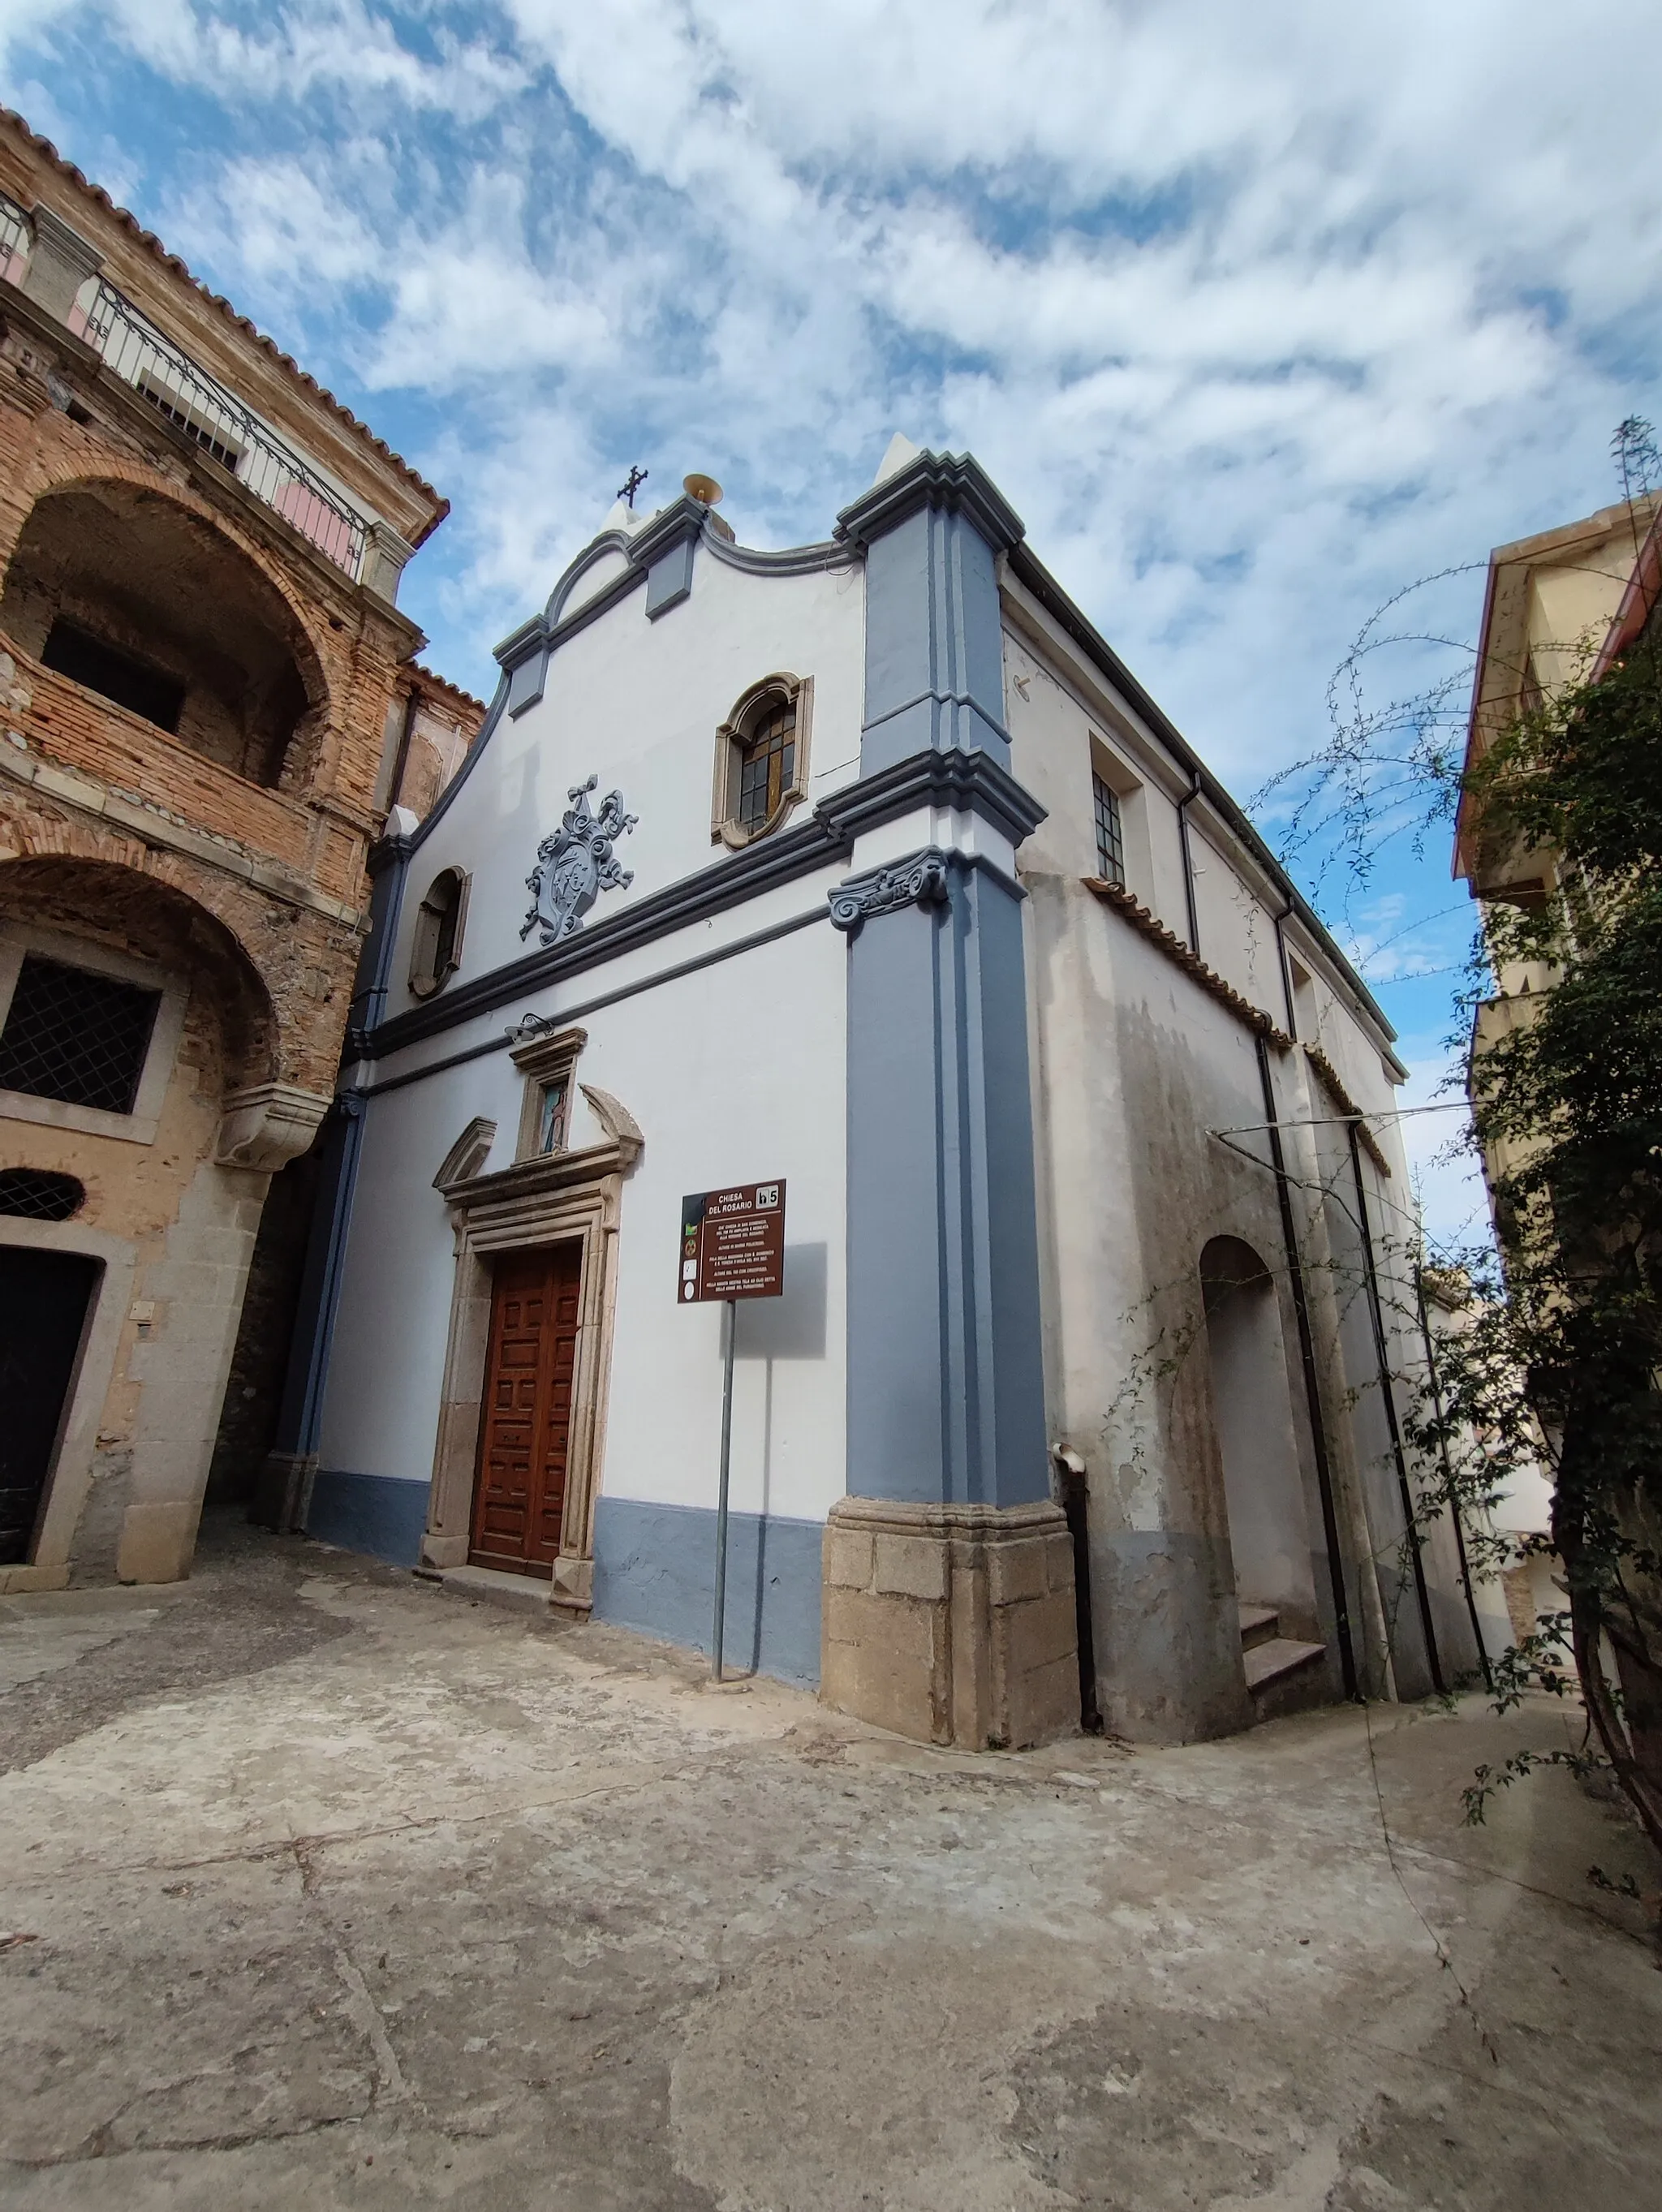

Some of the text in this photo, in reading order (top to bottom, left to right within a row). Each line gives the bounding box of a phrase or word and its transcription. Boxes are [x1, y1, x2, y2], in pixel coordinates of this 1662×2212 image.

[718, 1192, 743, 1203] CHIESA
[770, 1190, 777, 1203] 5
[708, 1201, 752, 1215] DEL ROSARIO
